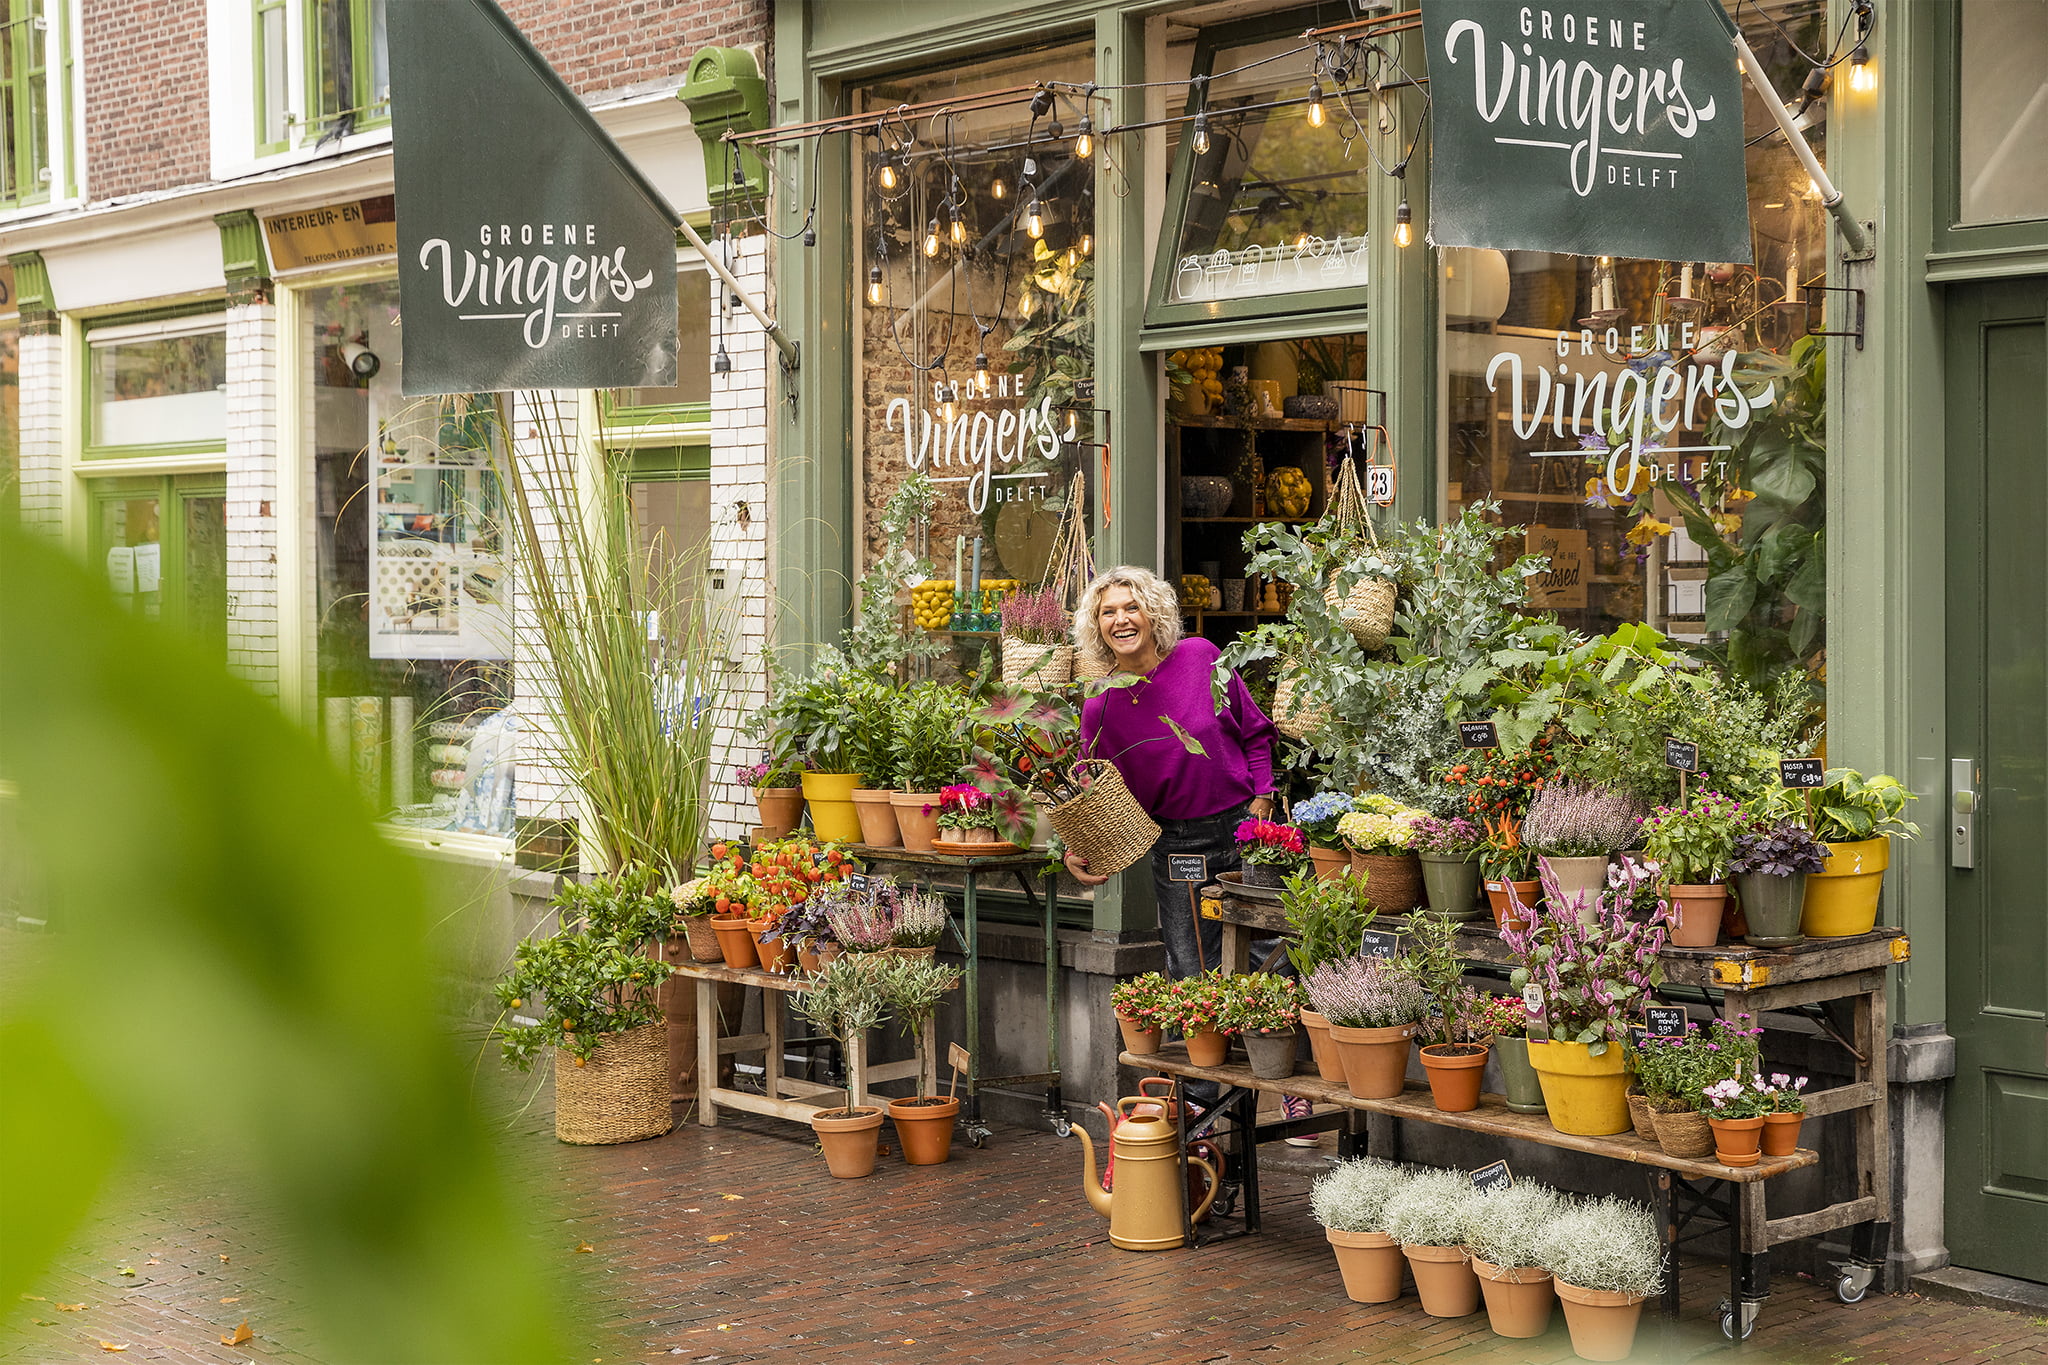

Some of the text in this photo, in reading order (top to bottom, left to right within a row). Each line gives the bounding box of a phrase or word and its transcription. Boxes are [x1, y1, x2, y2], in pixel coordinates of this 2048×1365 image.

[1520, 6, 1645, 51] GROENE
[1445, 19, 1716, 197] Vingers
[1607, 165, 1678, 189] DELFT
[342, 205, 361, 222] EN
[480, 224, 596, 246] GROENE
[304, 253, 337, 264] TELEFOON
[419, 238, 654, 349] Vingers
[562, 323, 620, 338] DELFT
[1557, 322, 1694, 357] GROENE
[1485, 350, 1775, 496] Vingers
[886, 396, 1077, 515] Vingers
[1650, 461, 1728, 482] DELFT
[996, 485, 1047, 503] DELFT
[1371, 472, 1388, 496] 23
